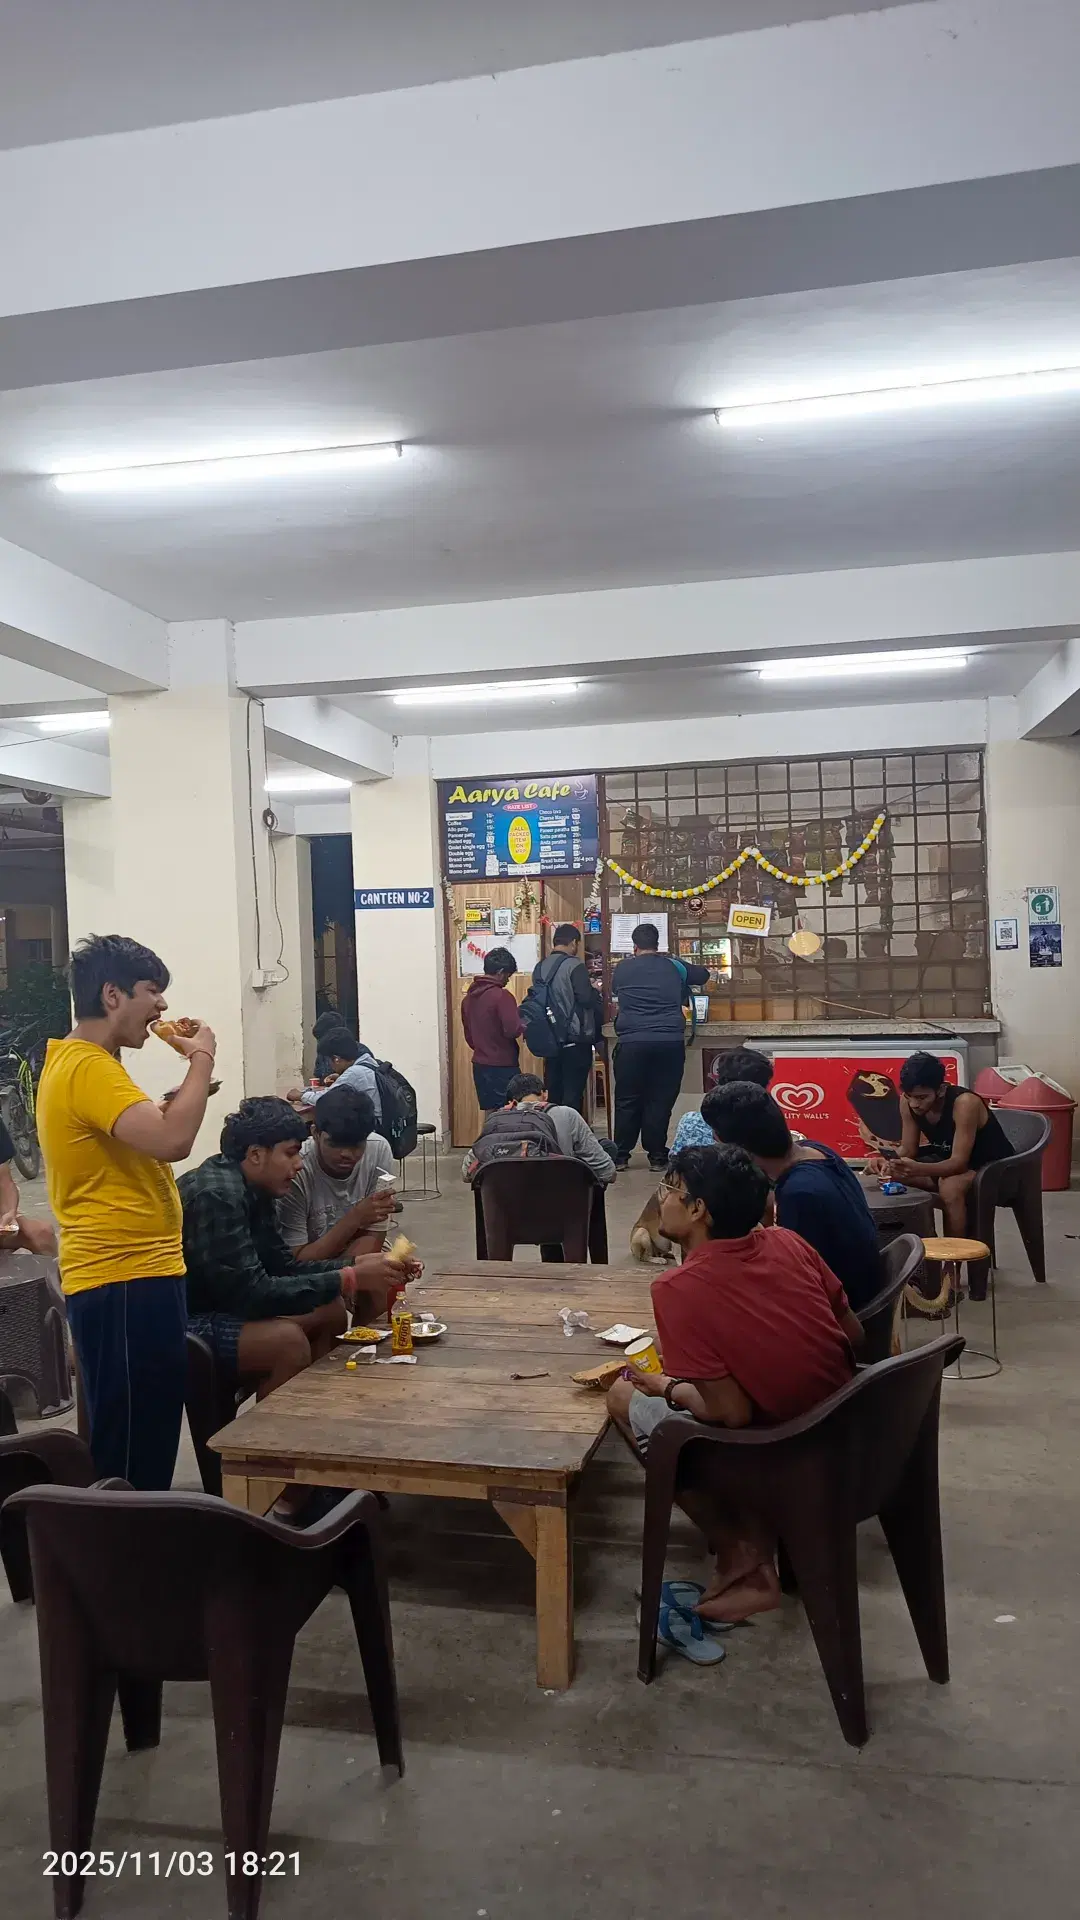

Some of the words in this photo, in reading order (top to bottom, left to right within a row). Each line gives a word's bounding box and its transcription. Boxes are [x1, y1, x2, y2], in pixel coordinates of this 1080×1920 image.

[448, 785, 520, 806] Aarya
[524, 781, 571, 801] Cafe
[1030, 887, 1054, 895] PLEASE
[360, 892, 406, 905] CANTEEN
[407, 890, 430, 904] NO-2
[736, 914, 762, 926] OPEN
[784, 1112, 801, 1120] LITY
[803, 1112, 830, 1120] WALL'S
